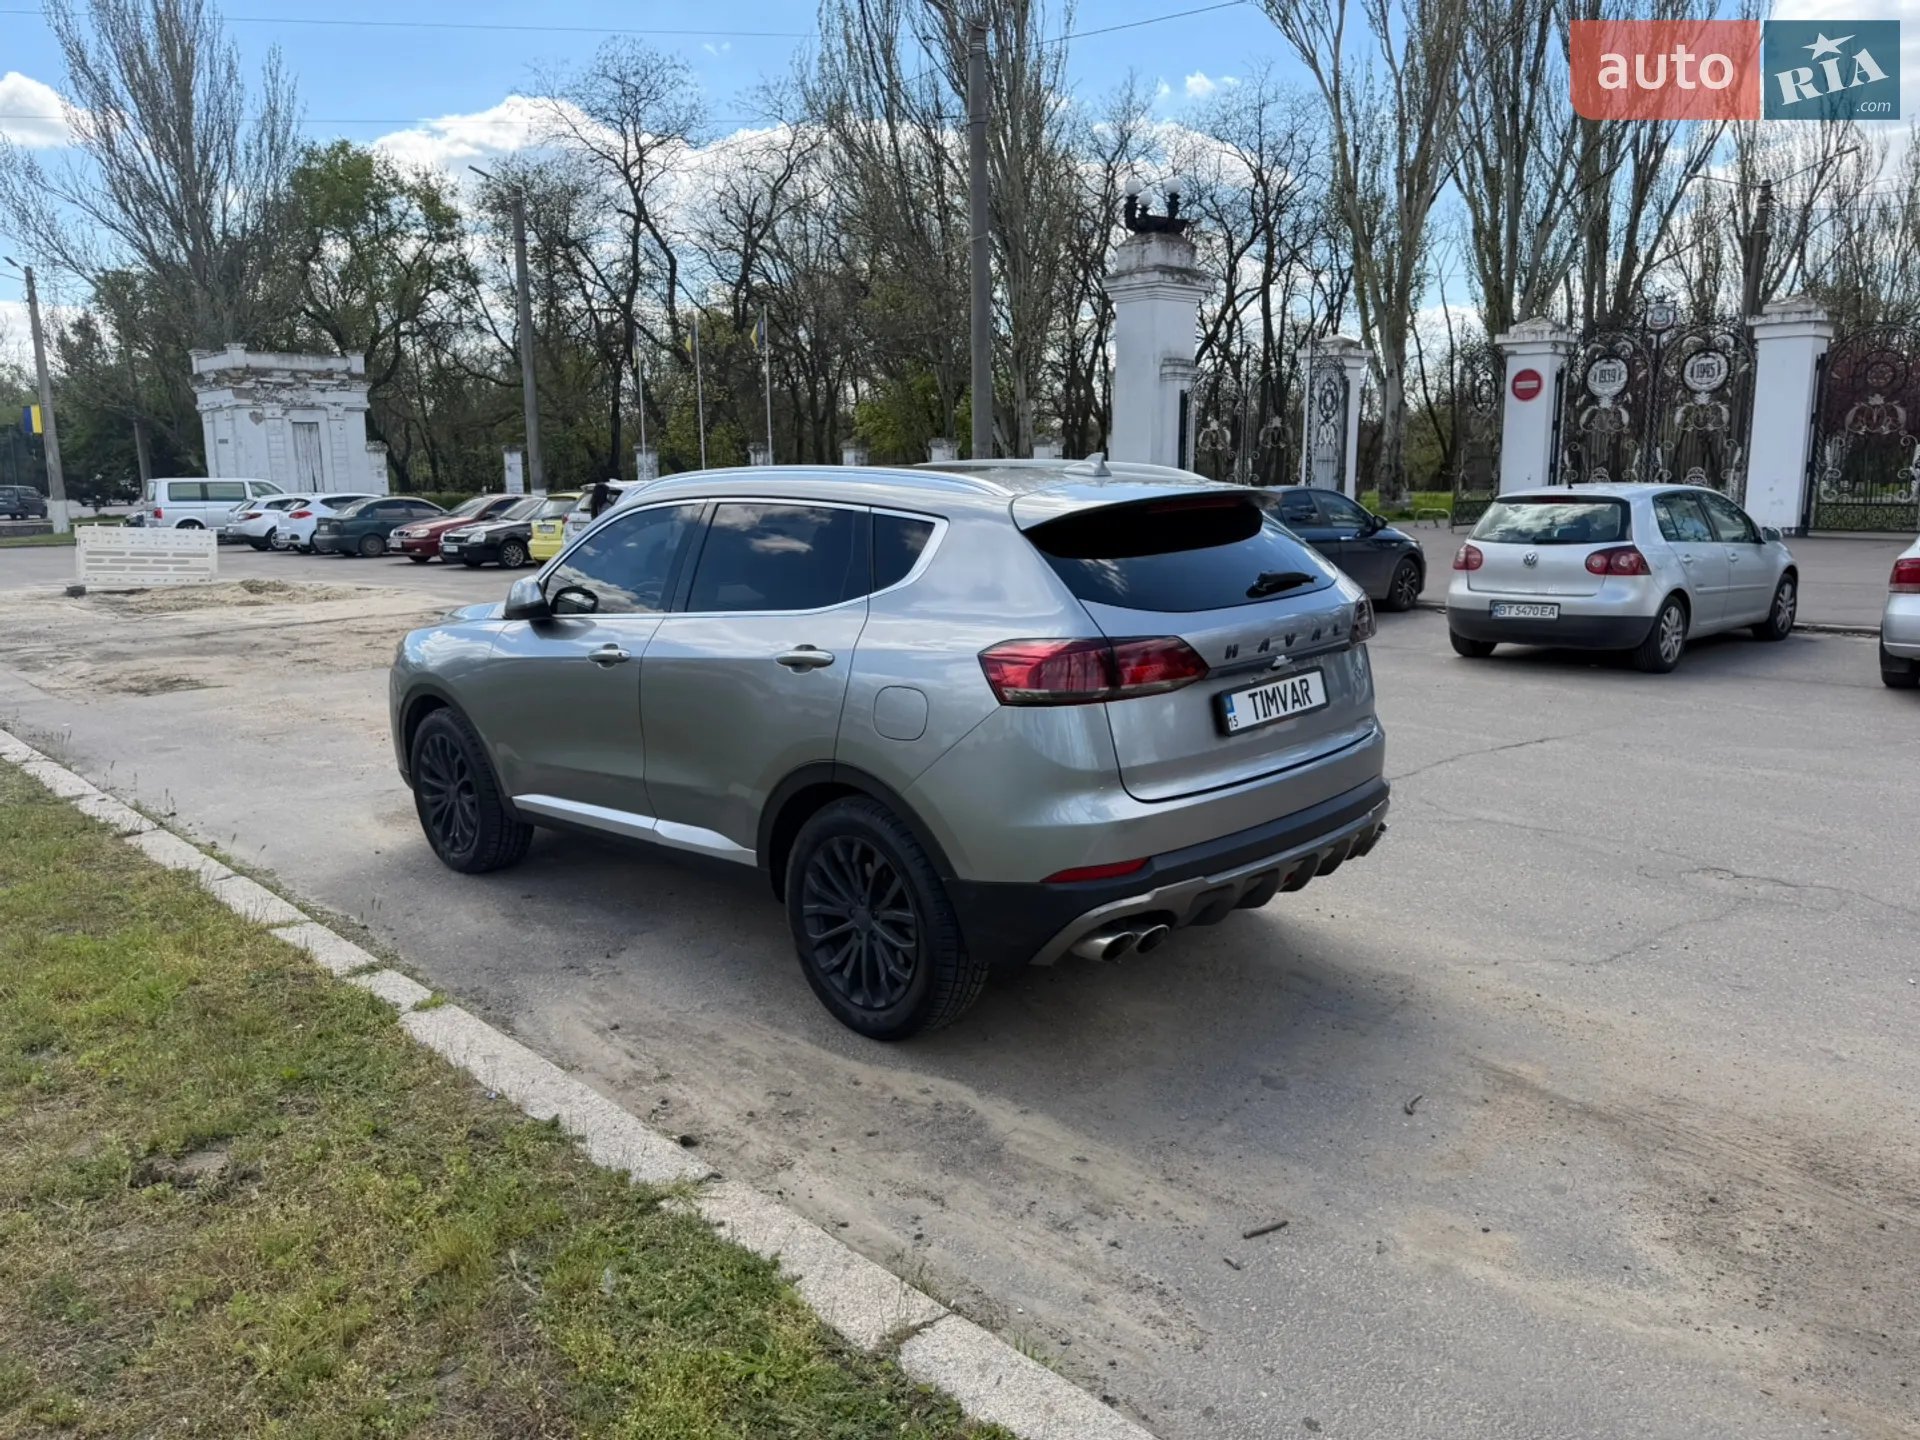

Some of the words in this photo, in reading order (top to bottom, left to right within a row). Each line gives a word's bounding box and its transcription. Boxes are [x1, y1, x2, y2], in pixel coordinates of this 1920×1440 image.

[1600, 369, 1617, 383] 1939
[1515, 605, 1539, 616] 5470
[1540, 606, 1556, 617] EA
[1225, 624, 1342, 660] HAVAL
[1248, 679, 1313, 720] TIMVAR
